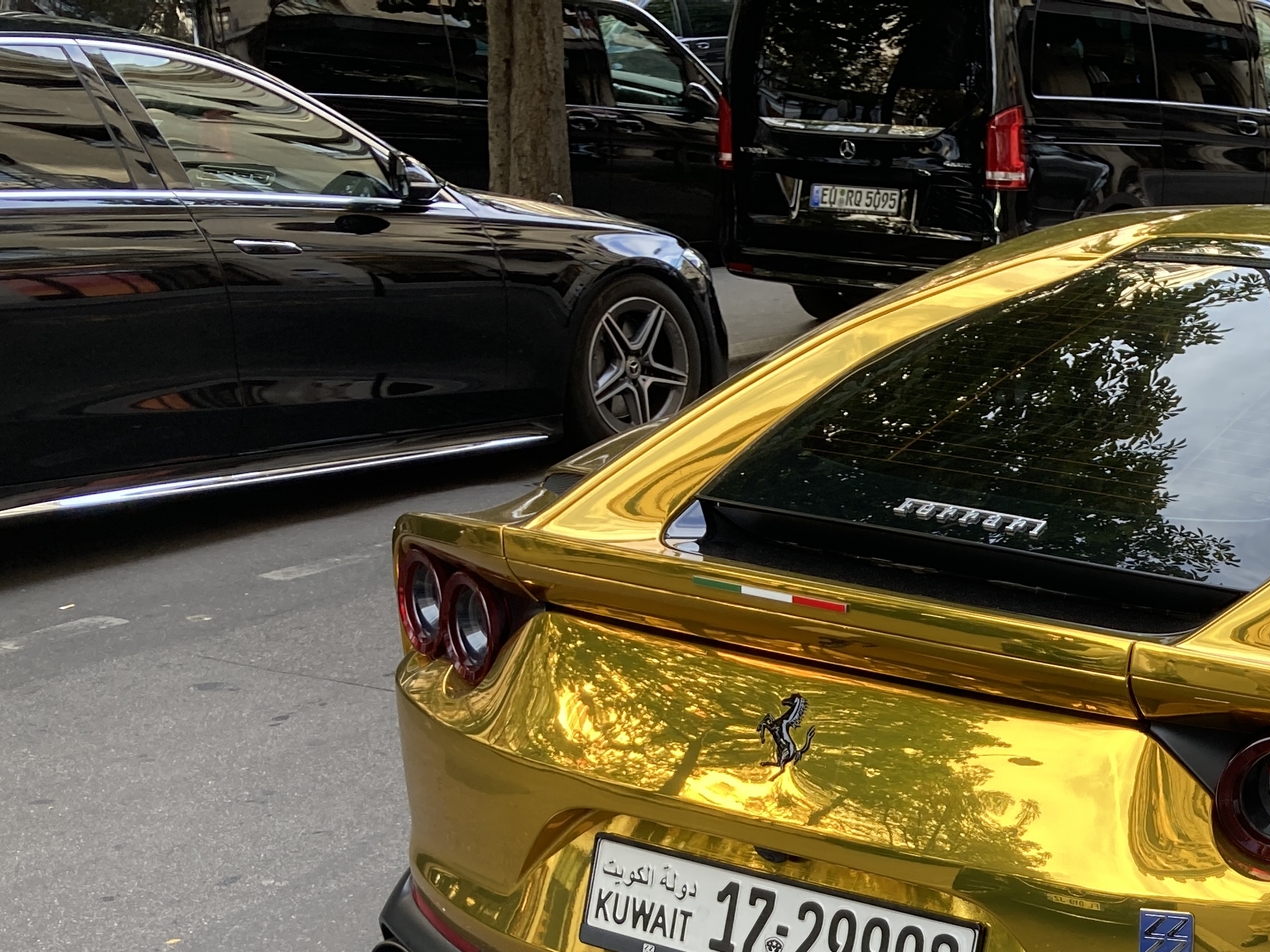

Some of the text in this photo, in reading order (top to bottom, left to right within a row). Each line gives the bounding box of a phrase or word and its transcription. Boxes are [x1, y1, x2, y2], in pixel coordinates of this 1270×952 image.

[864, 190, 898, 210] 5095
[893, 497, 1047, 538] Ferrari
[602, 860, 698, 901] دولة الكويت
[594, 887, 693, 942] KUWAIT
